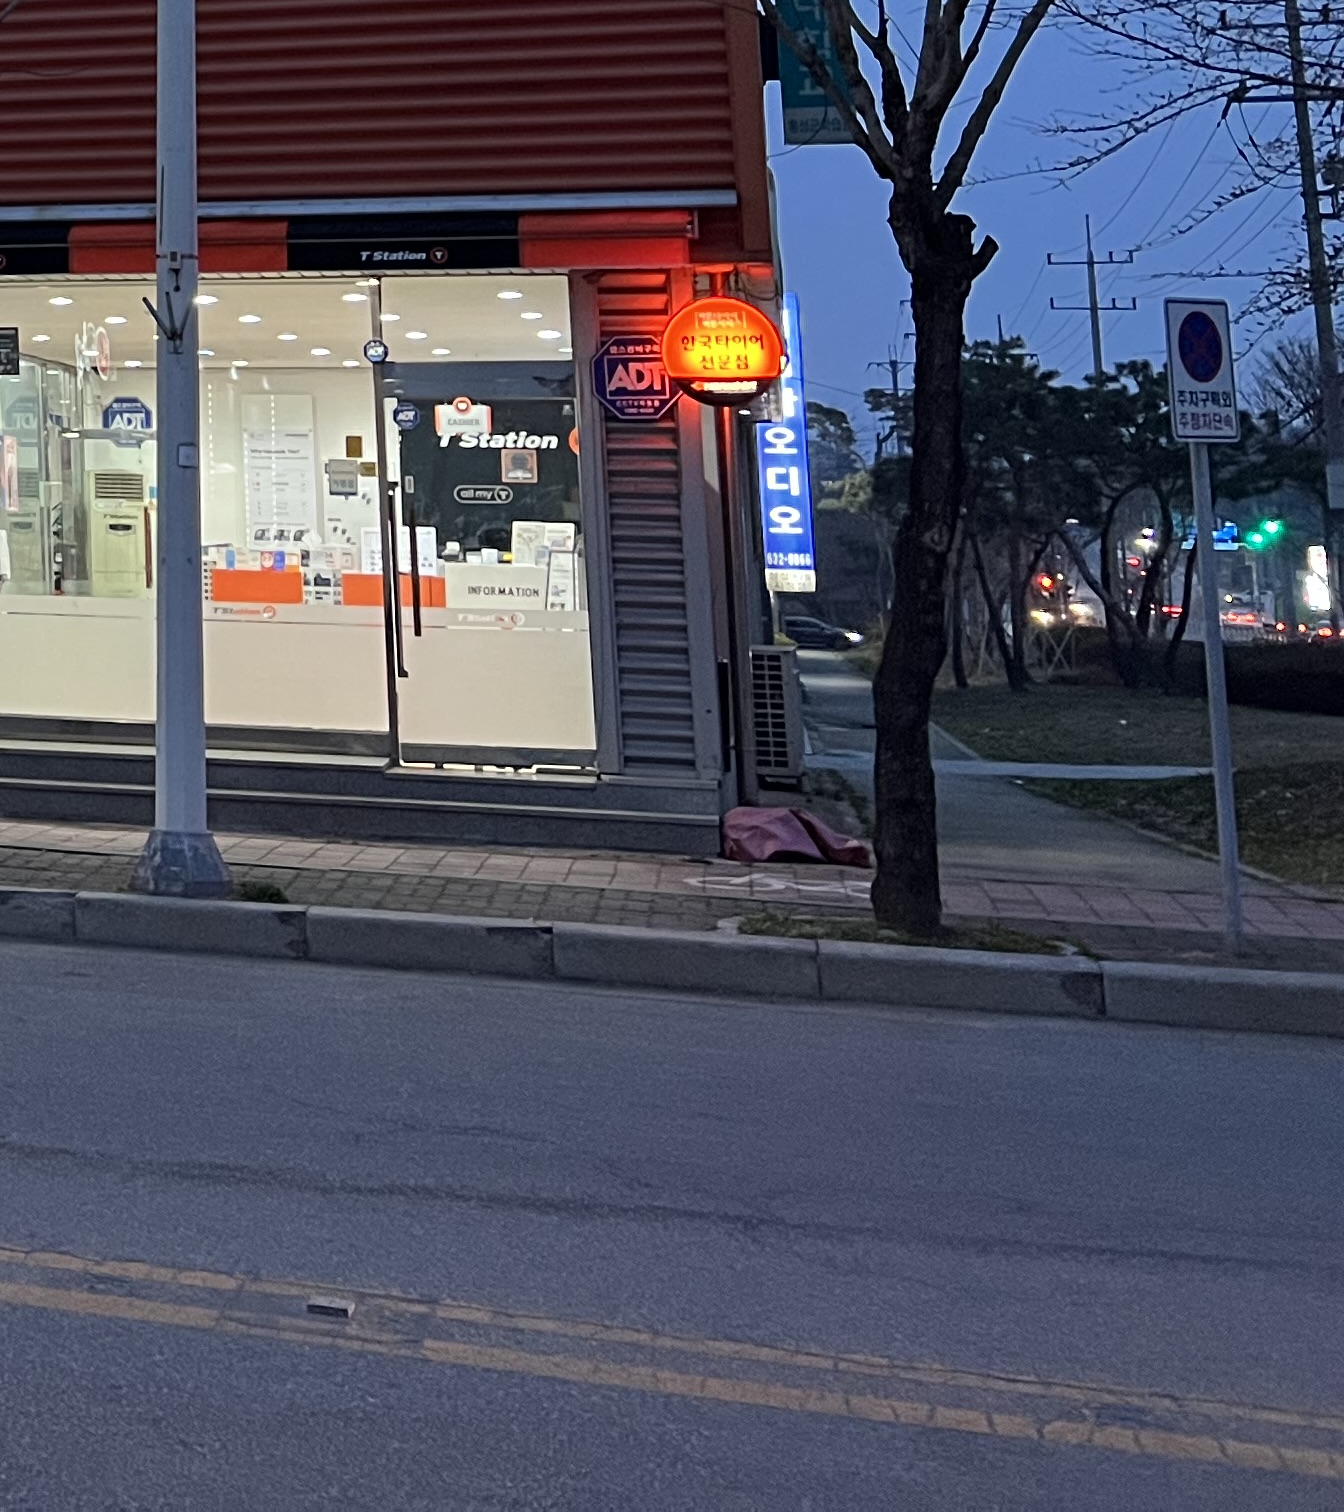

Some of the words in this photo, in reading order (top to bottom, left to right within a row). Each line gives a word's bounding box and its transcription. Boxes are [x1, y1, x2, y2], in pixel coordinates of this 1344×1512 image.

[682, 334, 765, 351] 한국타이어
[700, 354, 749, 370] 전문점
[608, 361, 666, 392] ADT
[111, 412, 146, 430] ADT
[468, 585, 540, 598] INFORMATION
